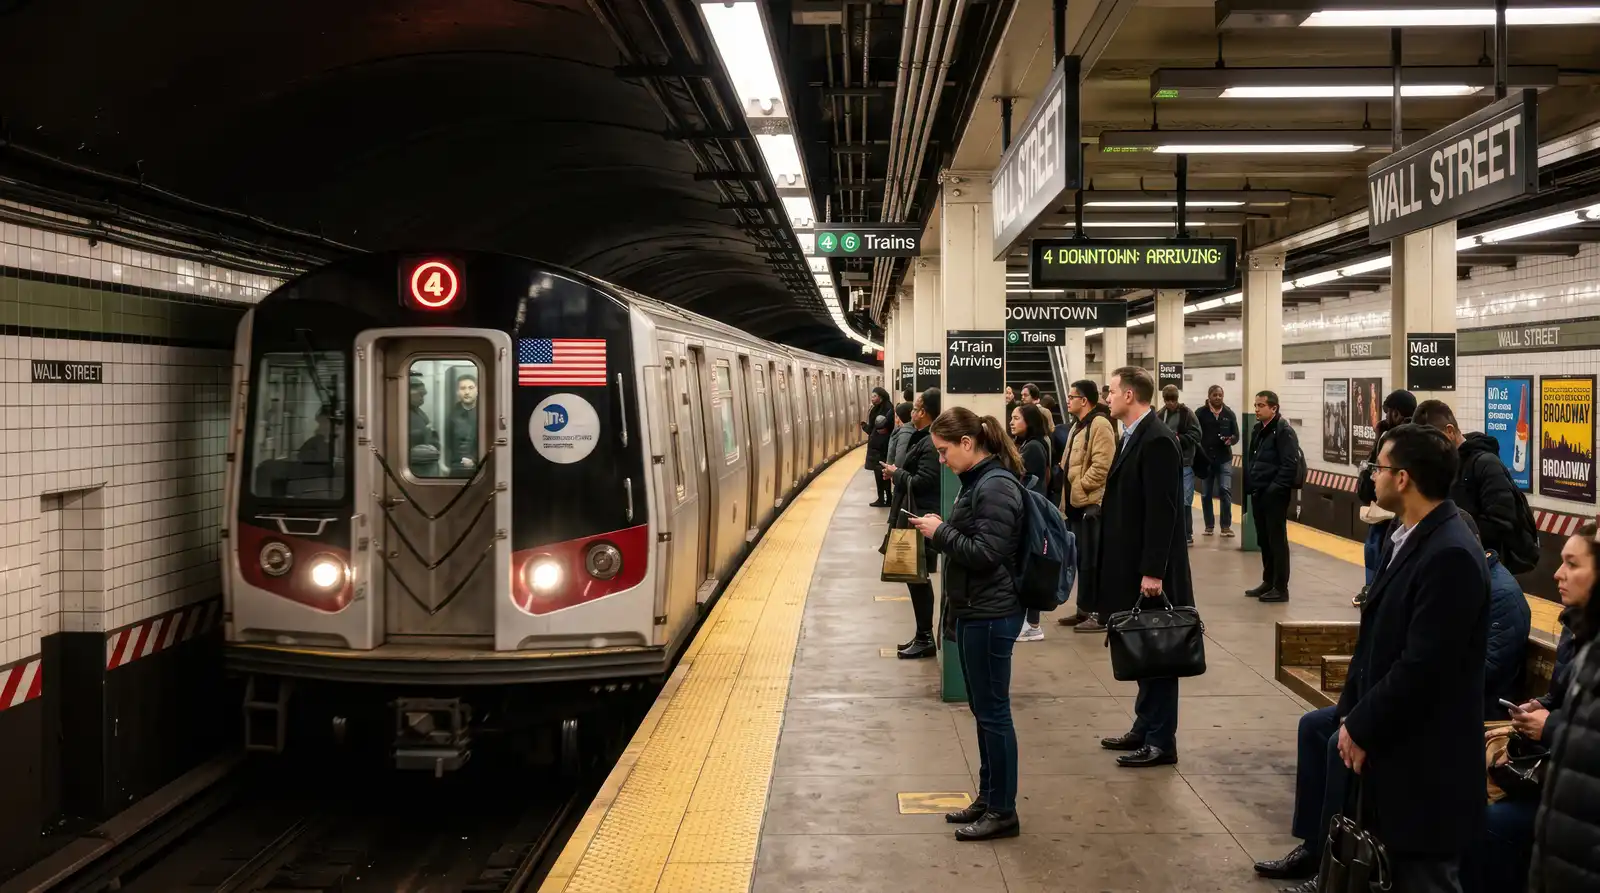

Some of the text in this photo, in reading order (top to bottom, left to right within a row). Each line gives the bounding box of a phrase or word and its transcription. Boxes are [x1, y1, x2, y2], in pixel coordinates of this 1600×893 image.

[1017, 88, 1062, 216] STREET
[1370, 113, 1522, 226] WALL STREET
[821, 234, 916, 250] 4 6 Trains
[1043, 249, 1053, 265] 4
[424, 272, 444, 296] 4
[1497, 327, 1560, 347] WALL STREET
[949, 354, 1002, 369] Arriving
[1410, 355, 1450, 367] Street
[33, 363, 101, 380] WALL STREET
[1543, 403, 1590, 424] BROADWAY
